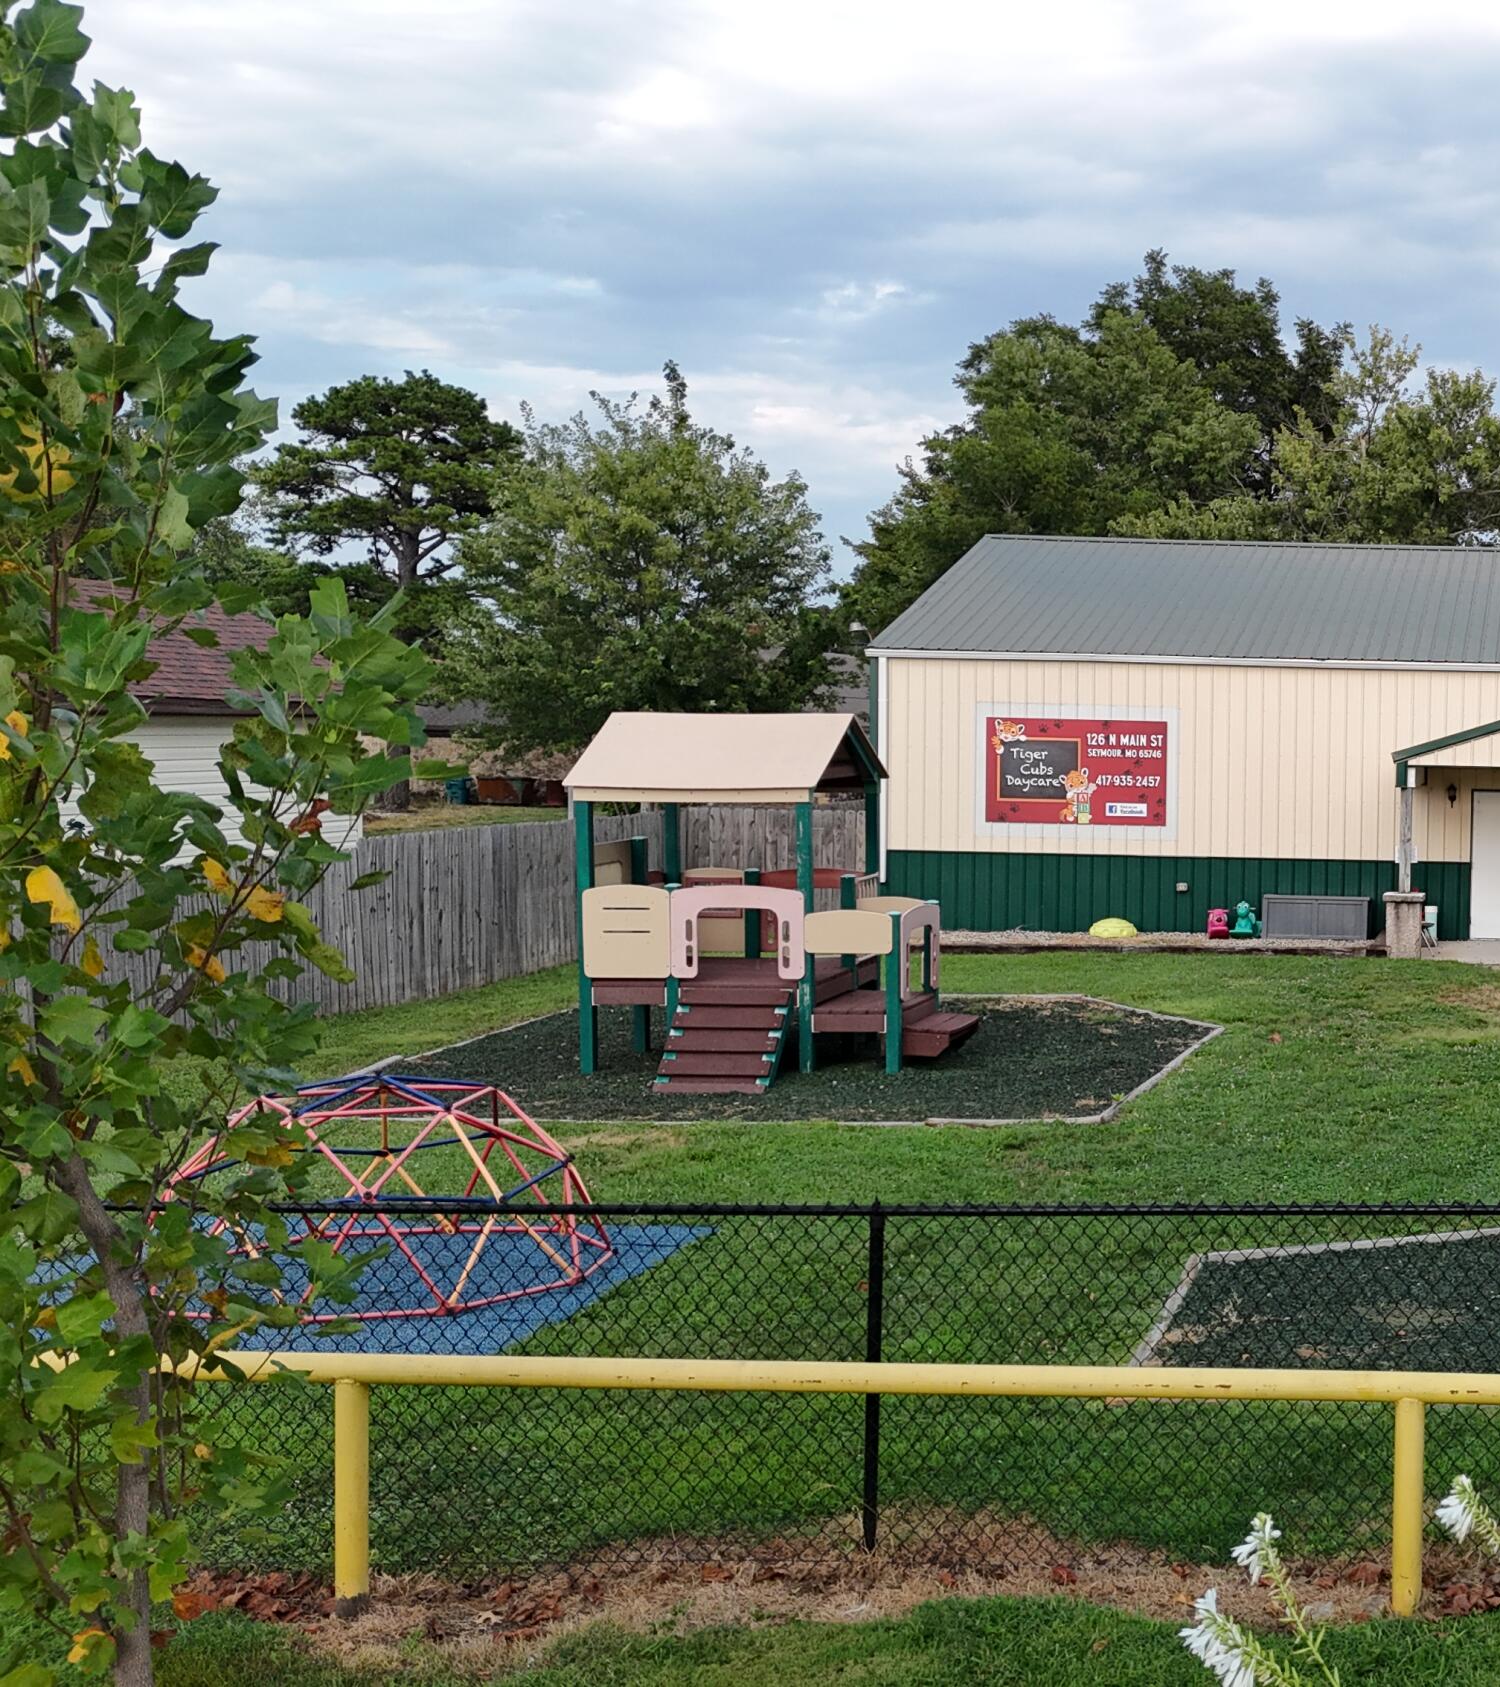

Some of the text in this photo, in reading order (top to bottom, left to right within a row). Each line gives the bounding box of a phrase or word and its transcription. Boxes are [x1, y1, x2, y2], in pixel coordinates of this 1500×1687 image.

[1086, 733, 1164, 747] 126 N MAIN ST
[1010, 747, 1048, 763] Tiger
[1125, 749, 1137, 758] MO
[1138, 750, 1162, 758] 65746
[1020, 761, 1053, 775] Cubs
[1005, 774, 1061, 792] Daycare
